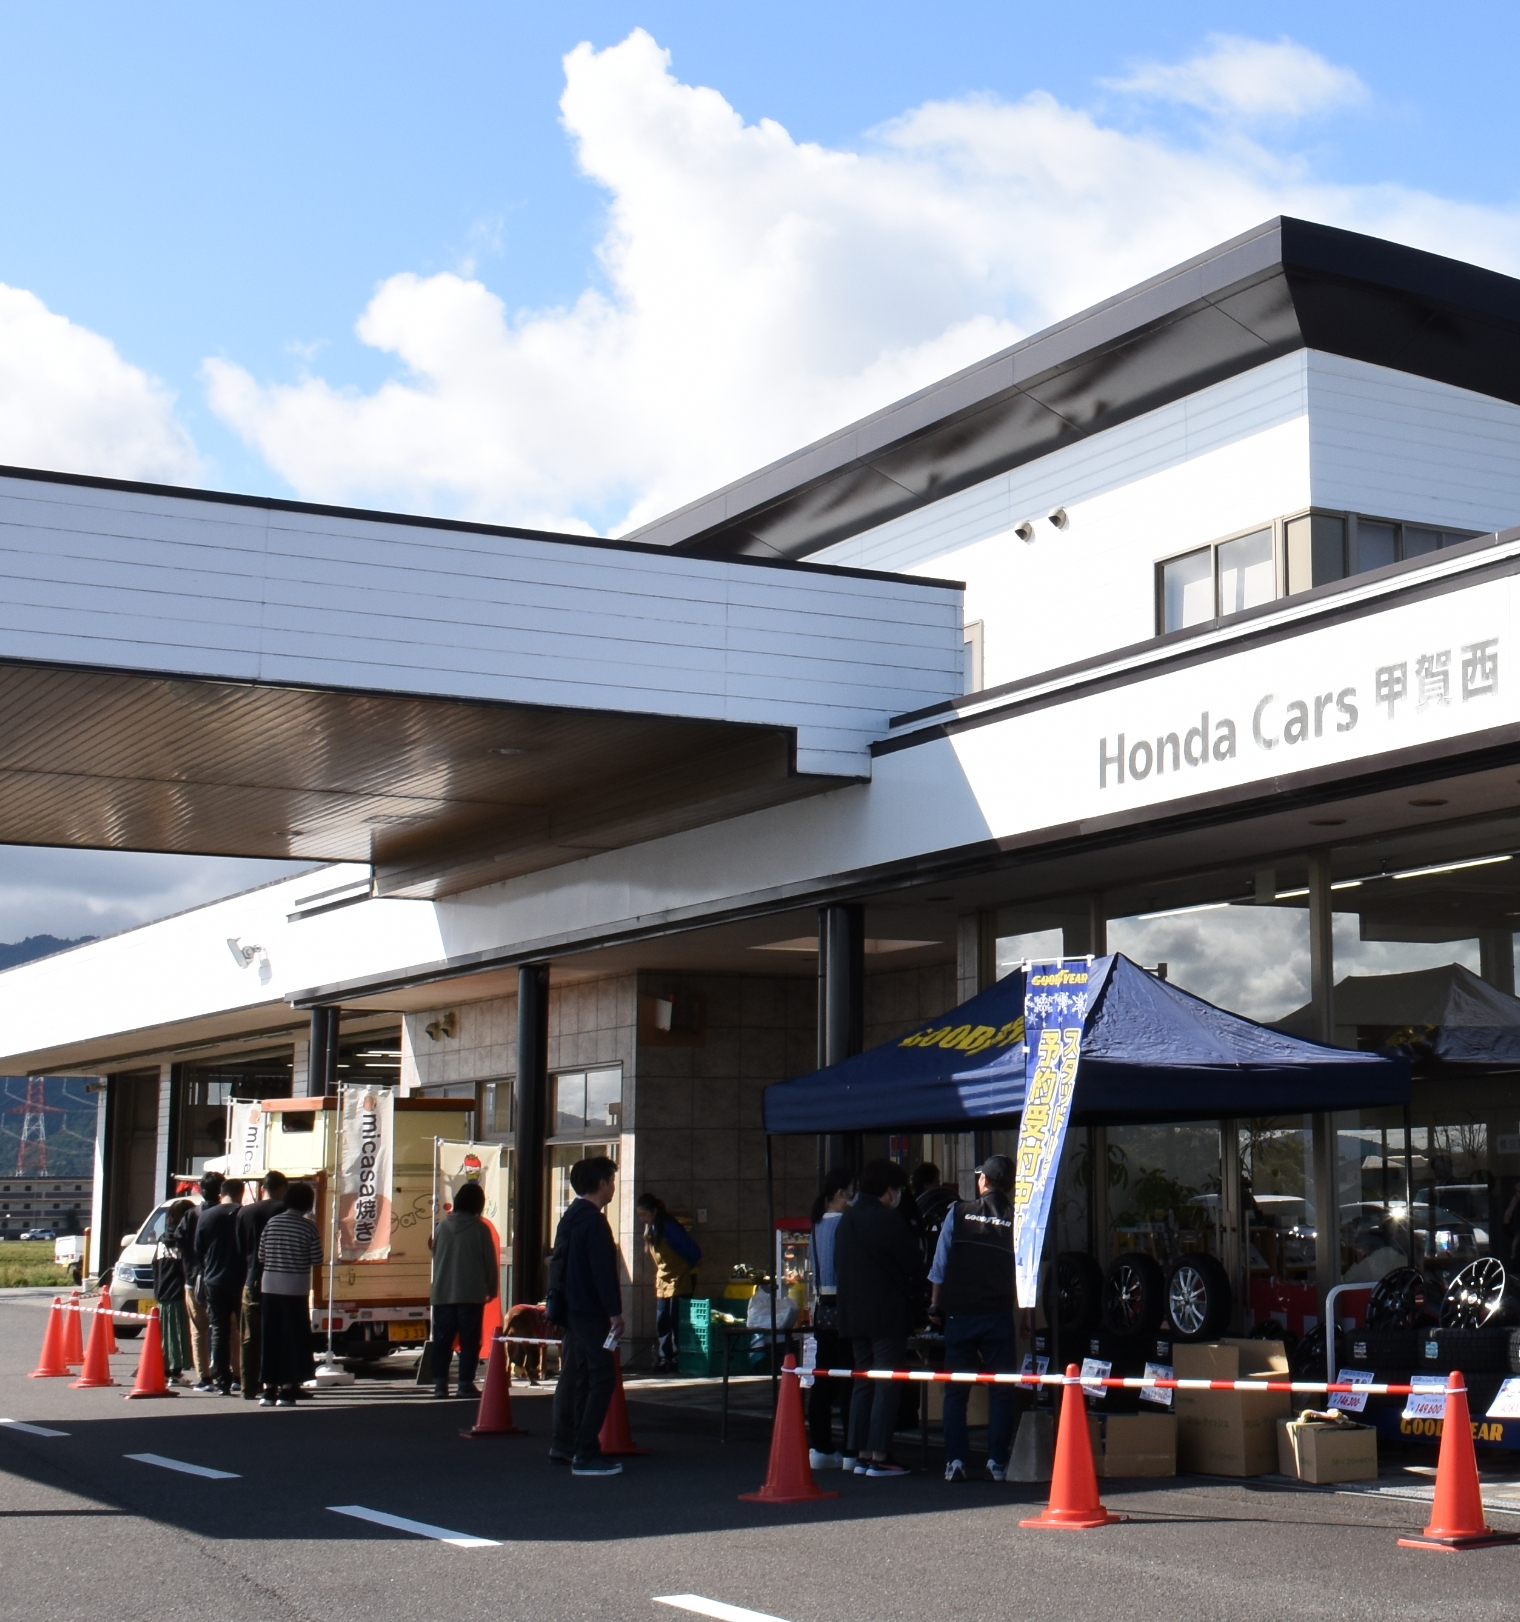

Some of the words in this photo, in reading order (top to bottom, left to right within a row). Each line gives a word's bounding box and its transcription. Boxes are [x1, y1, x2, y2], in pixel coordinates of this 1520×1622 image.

[1098, 709, 1238, 790] Honda
[1251, 685, 1359, 751] Cars
[1374, 636, 1501, 721] 甲賀西
[355, 1114, 381, 1242] micasa焼き
[964, 1213, 1012, 1228] GOODYEAR
[1400, 1418, 1504, 1442] GOODEAR
